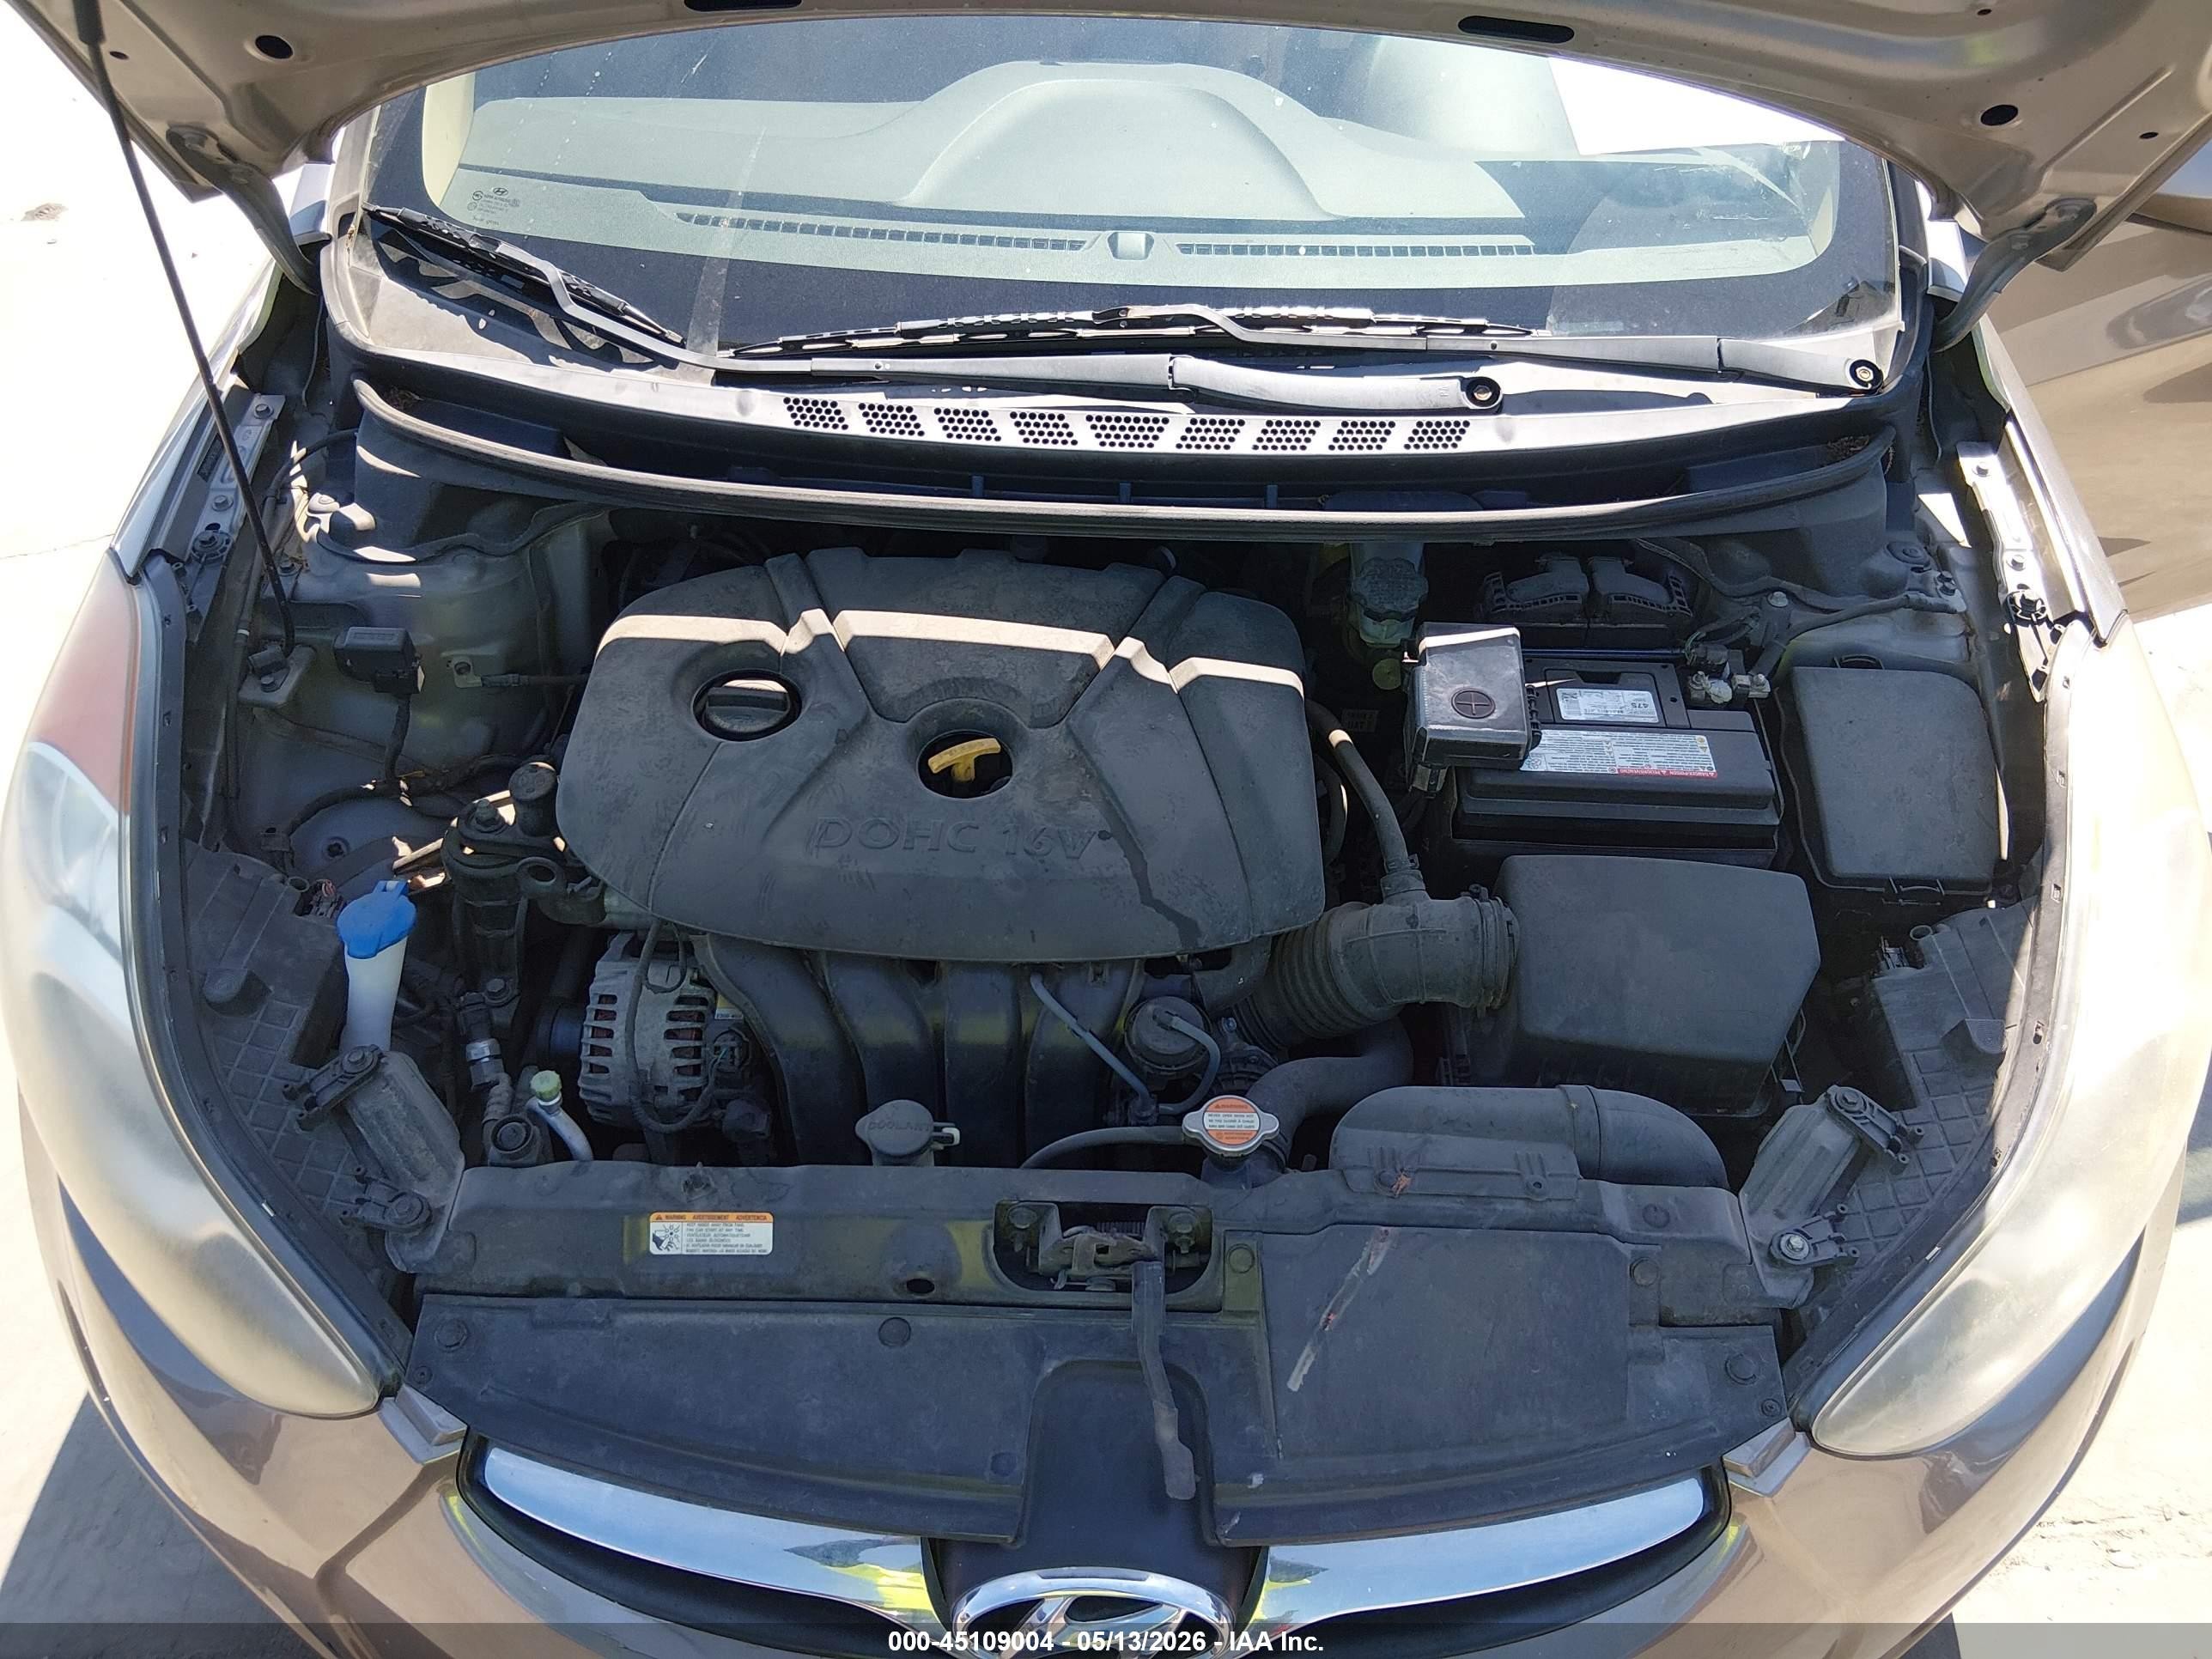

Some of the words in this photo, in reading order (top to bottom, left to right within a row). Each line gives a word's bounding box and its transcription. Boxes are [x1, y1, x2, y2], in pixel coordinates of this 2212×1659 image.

[814, 817, 979, 854] DOHC
[1001, 823, 1098, 860] 16V
[867, 1120, 930, 1133] COOLANT
